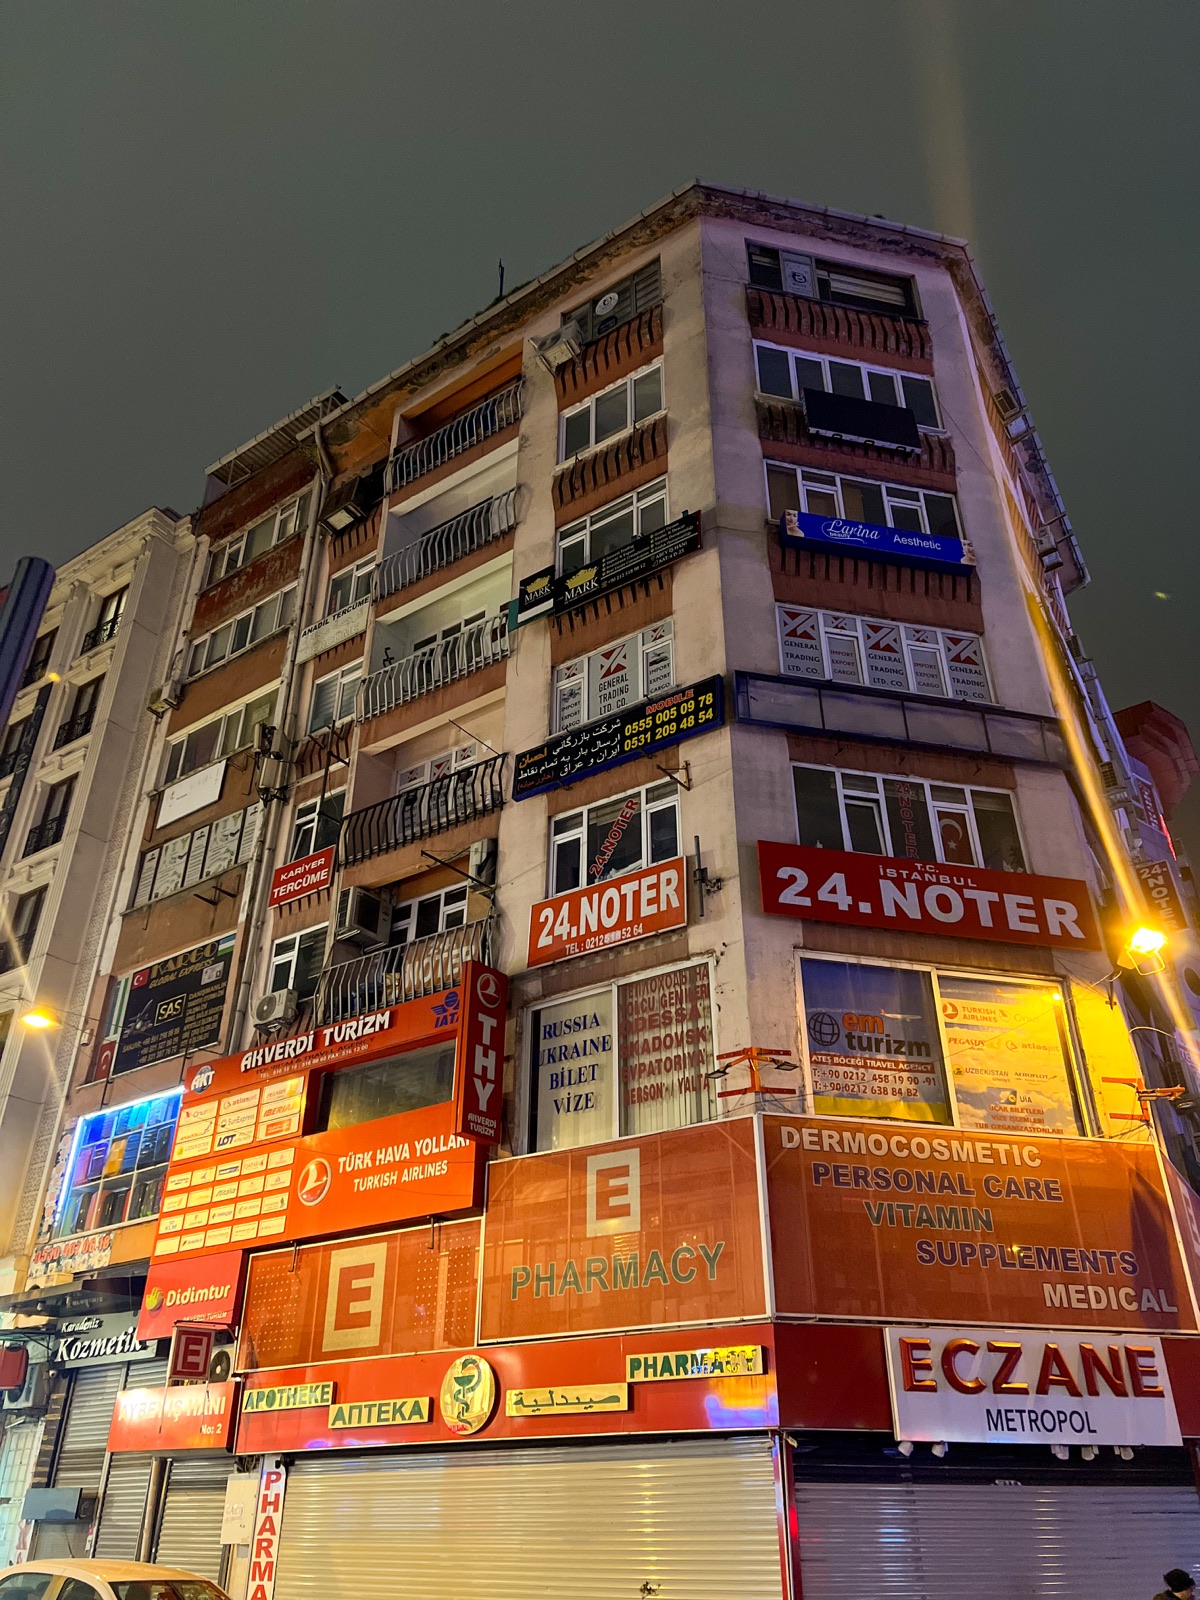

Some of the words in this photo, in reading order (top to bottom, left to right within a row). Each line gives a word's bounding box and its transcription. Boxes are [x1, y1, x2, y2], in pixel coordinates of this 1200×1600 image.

[827, 520, 880, 540] Larina
[893, 534, 941, 551] Aesthetic
[524, 583, 551, 603] MARK
[564, 576, 599, 603] MARK
[784, 640, 819, 651] GENERAL
[785, 652, 820, 663] TRADING
[832, 659, 855, 667] EXPORT
[868, 653, 902, 664] GENERAL
[650, 662, 670, 676] IMPORT
[650, 672, 670, 684] EXPORT
[788, 664, 804, 672] LTD.
[806, 666, 820, 675] CO.
[833, 668, 856, 676] CARGO
[870, 664, 904, 676] TRADING
[916, 671, 938, 679] EXPORT
[950, 665, 982, 676] GENERAL
[598, 673, 628, 692] GENERAL
[650, 682, 670, 694] CARGO
[872, 676, 889, 685] LTD.
[890, 680, 904, 688] CO.
[918, 681, 940, 689] CARGO
[952, 677, 986, 688] TRADING
[598, 684, 630, 704] TRADING
[646, 688, 694, 714] MOBILE
[955, 689, 971, 698] LTD.
[972, 691, 987, 700] CO.
[562, 700, 580, 712] IMPORT
[599, 704, 614, 716] LTD.
[616, 698, 629, 711] CO.
[624, 716, 652, 737] 0555
[656, 708, 677, 726] 005
[680, 700, 695, 715] 09
[698, 692, 714, 706] 78
[562, 710, 580, 722] EXPORT
[562, 718, 580, 731] CARGO
[624, 732, 651, 752] 0531
[655, 724, 677, 741] 209
[680, 716, 694, 730] 48
[698, 708, 714, 722] 54
[590, 734, 620, 752] ارسال
[574, 748, 588, 760] بار
[588, 758, 594, 766] و
[518, 766, 538, 780] نقاط
[540, 758, 558, 774] تمام
[560, 760, 584, 777] عراق
[895, 783, 914, 795] 24.
[589, 798, 640, 876] 24.NOTER
[899, 797, 918, 860] NOTER
[280, 858, 326, 882] KARİYER
[879, 864, 978, 888] İSTANBUL
[914, 862, 940, 874] T.C.
[1140, 864, 1168, 879] 24.
[273, 868, 328, 898] TERCÜME
[537, 868, 680, 949] 24.NOTER
[776, 866, 1086, 940] 24.NOTER
[586, 934, 604, 950] 0212
[622, 928, 632, 940] 52
[633, 922, 644, 936] 64
[159, 1000, 182, 1020] SAS
[962, 1006, 996, 1015] TURKISH
[962, 1014, 998, 1022] AIRLINES
[542, 1012, 600, 1040] RUSSIA
[842, 1012, 885, 1034] em
[241, 1030, 314, 1073] AKVERDİ
[323, 1010, 390, 1046] TURİZM
[845, 1031, 932, 1058] turizm
[948, 1037, 986, 1048] PEGASUS
[473, 1012, 498, 1112] THY
[812, 1054, 832, 1065] ATEŞ
[834, 1056, 864, 1066] BÖCEĞİ
[866, 1060, 897, 1070] TRAVEL
[898, 1062, 932, 1072] AGENCY
[190, 1068, 216, 1091] AKT
[549, 1064, 598, 1090] BİLET
[842, 1070, 866, 1082] 0212
[872, 1074, 890, 1084] 458
[893, 1075, 904, 1085] 19
[908, 1076, 920, 1086] 90
[922, 1077, 936, 1086] -91
[965, 1067, 1009, 1077] UZBEKISTAN
[1014, 1072, 1048, 1080] AEROFLOT
[678, 1073, 710, 1094] YALTA
[844, 1083, 868, 1094] 0212
[870, 1085, 888, 1096] 638
[892, 1086, 904, 1096] 84
[906, 1088, 919, 1097] 82
[263, 1103, 292, 1118] IBERIA
[553, 1092, 594, 1115] VİZE
[228, 1114, 255, 1125] SunExpress
[468, 1112, 496, 1129] AKVERDİ
[470, 1122, 494, 1137] TURİZM
[217, 1134, 237, 1148] LOT
[780, 1126, 1042, 1168] DERMOCOSMETIC
[338, 1149, 373, 1174] TÜRK
[375, 1142, 410, 1166] HAVA
[354, 1169, 398, 1192] TURKISH
[401, 1160, 448, 1184] AIRLINES
[812, 1162, 976, 1196] PERSONAL
[984, 1174, 1062, 1202] CARE
[863, 1201, 994, 1232] VITAMIN
[34, 1246, 60, 1264] 0530
[916, 1240, 1140, 1276] SUPPLEMENTS
[510, 1242, 726, 1300] PHARMACY
[166, 1284, 231, 1308] Didimtur
[1042, 1283, 1178, 1313] MEDICAL
[61, 1318, 100, 1332] Karadeniz
[629, 1344, 758, 1379] PHARMACY
[899, 1336, 1165, 1398] ECZANE
[244, 1382, 331, 1410] APOTHEKE
[513, 1390, 620, 1413] صيدلية
[331, 1400, 424, 1426] АПТЕКА
[986, 1408, 1097, 1434] METROPOL
[200, 1424, 214, 1434] No:
[216, 1424, 222, 1434] 2
